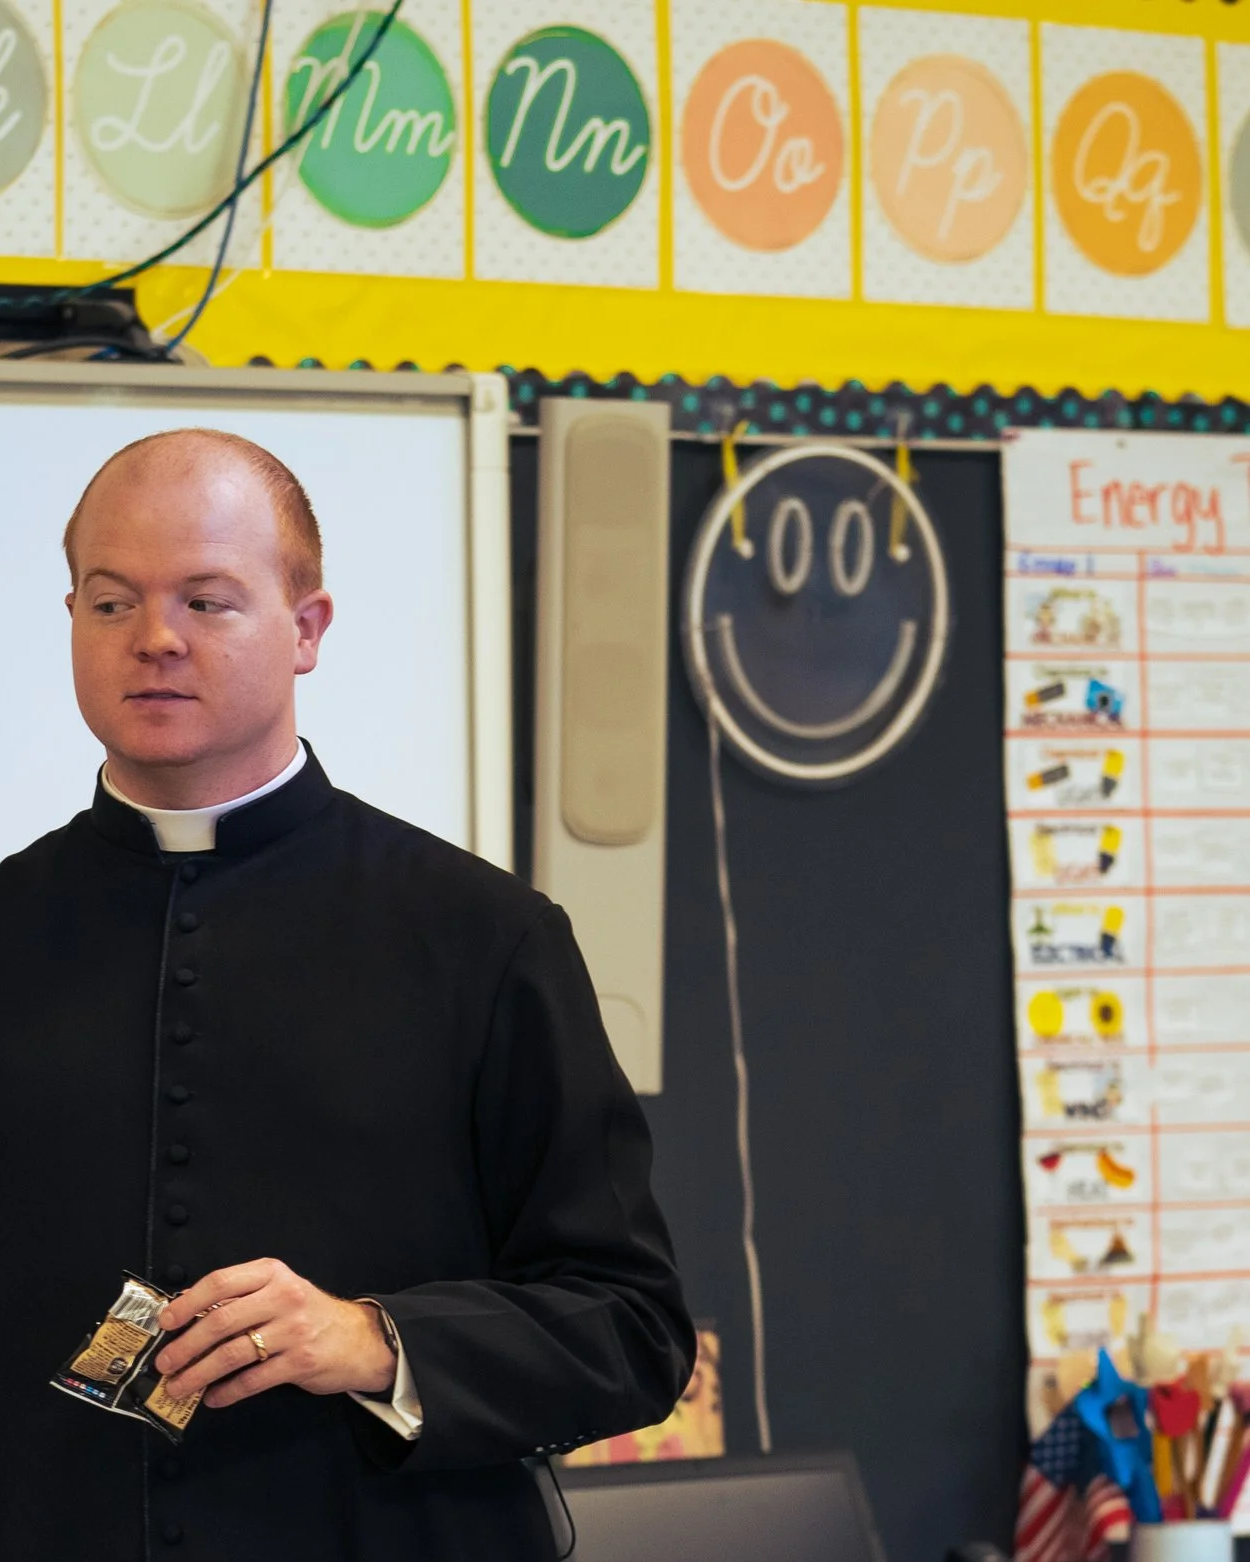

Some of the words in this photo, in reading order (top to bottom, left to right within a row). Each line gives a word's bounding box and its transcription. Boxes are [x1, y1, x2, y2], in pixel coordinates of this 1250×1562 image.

[91, 34, 229, 155] Ll
[291, 55, 456, 158] Mm
[503, 56, 644, 175] Nn
[708, 73, 826, 194] Oo
[895, 88, 1004, 242] Pp
[1072, 101, 1182, 252] Qq
[1068, 459, 1227, 557] Energy
